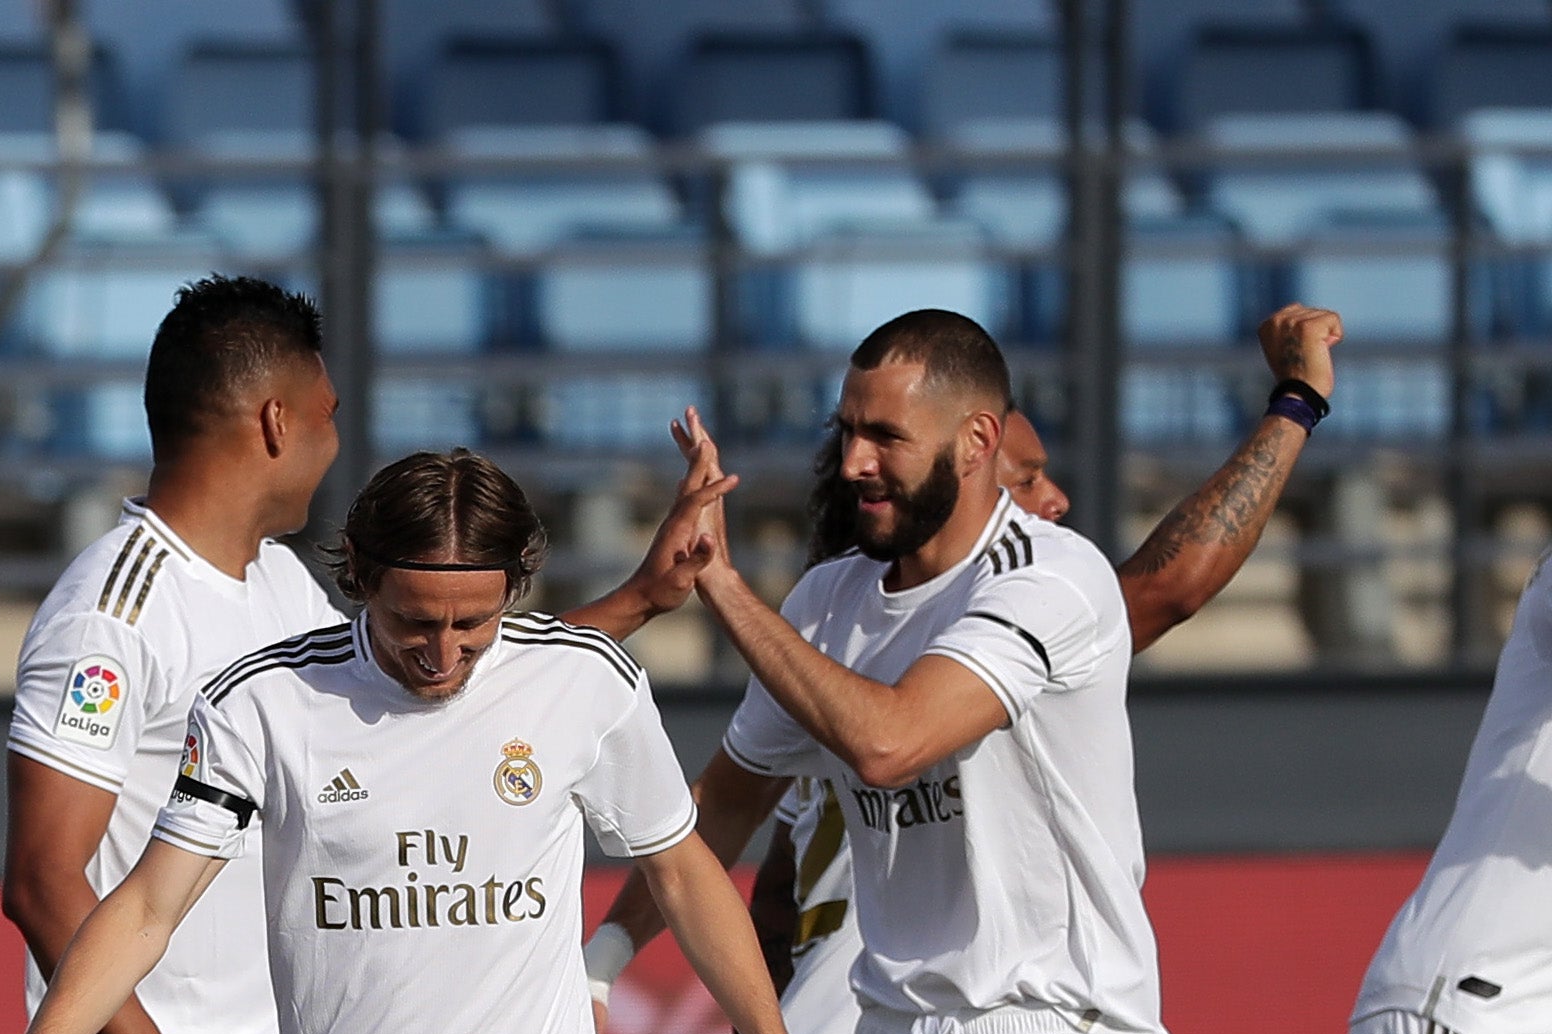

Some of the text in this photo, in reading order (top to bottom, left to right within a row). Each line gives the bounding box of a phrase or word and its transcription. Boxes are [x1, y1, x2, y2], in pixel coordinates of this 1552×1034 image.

[61, 713, 110, 736] LaLiga
[317, 789, 369, 804] adidas
[395, 829, 468, 873] Fly
[311, 872, 546, 930] Emirates
